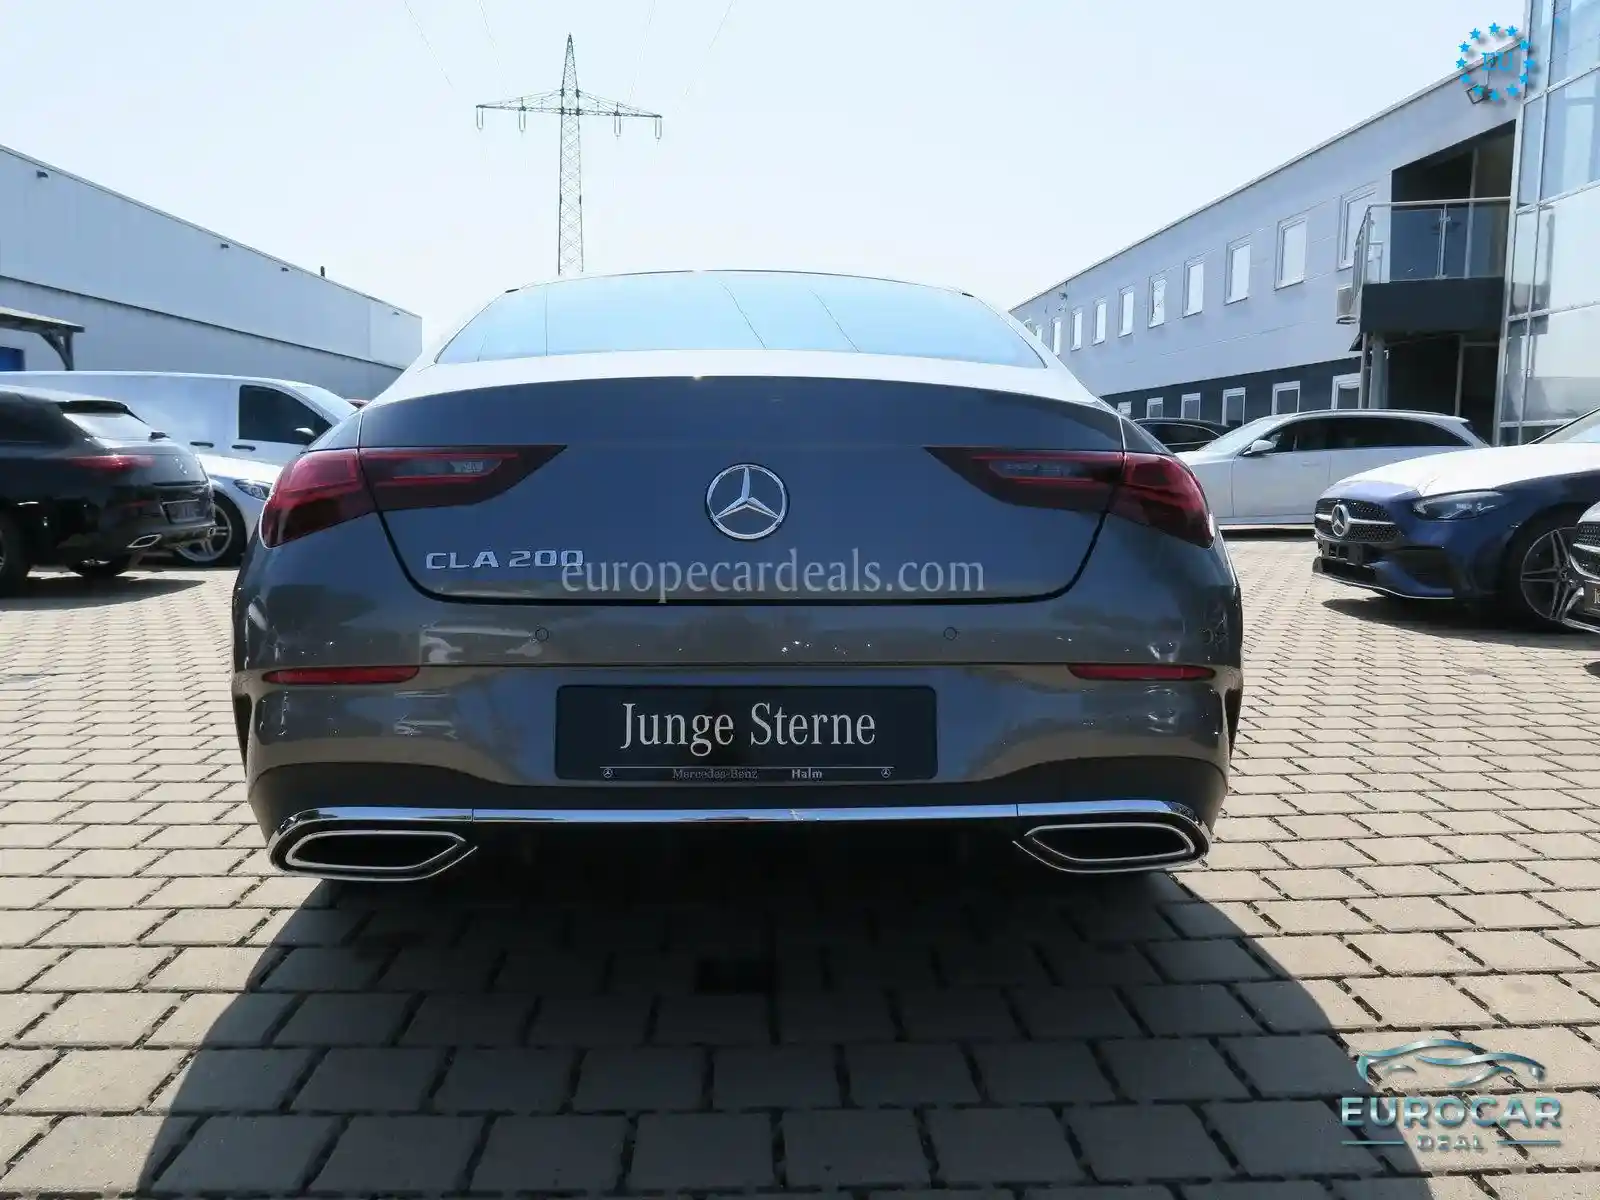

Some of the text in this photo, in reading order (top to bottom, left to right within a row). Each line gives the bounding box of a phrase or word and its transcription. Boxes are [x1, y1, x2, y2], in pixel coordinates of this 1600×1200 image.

[425, 549, 584, 570] CLA 200
[620, 702, 876, 756] Junge Sterne
[791, 768, 823, 780] Halm
